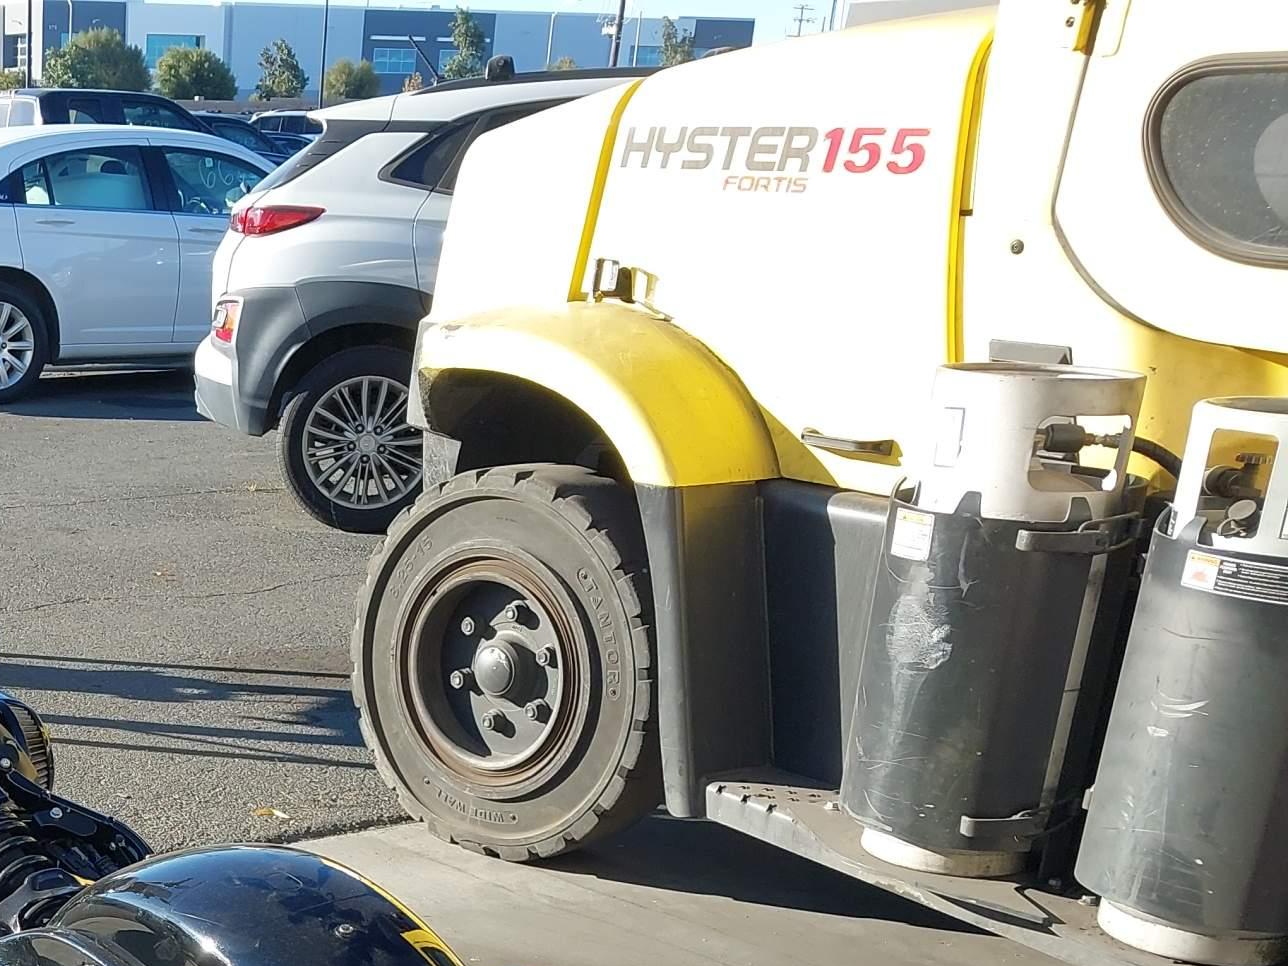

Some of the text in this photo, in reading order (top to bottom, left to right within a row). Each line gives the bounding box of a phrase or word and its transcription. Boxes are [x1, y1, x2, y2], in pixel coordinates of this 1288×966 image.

[620, 126, 931, 174] HYSTER 155
[722, 175, 809, 193] FORTIS
[584, 577, 621, 685] TANTOR
